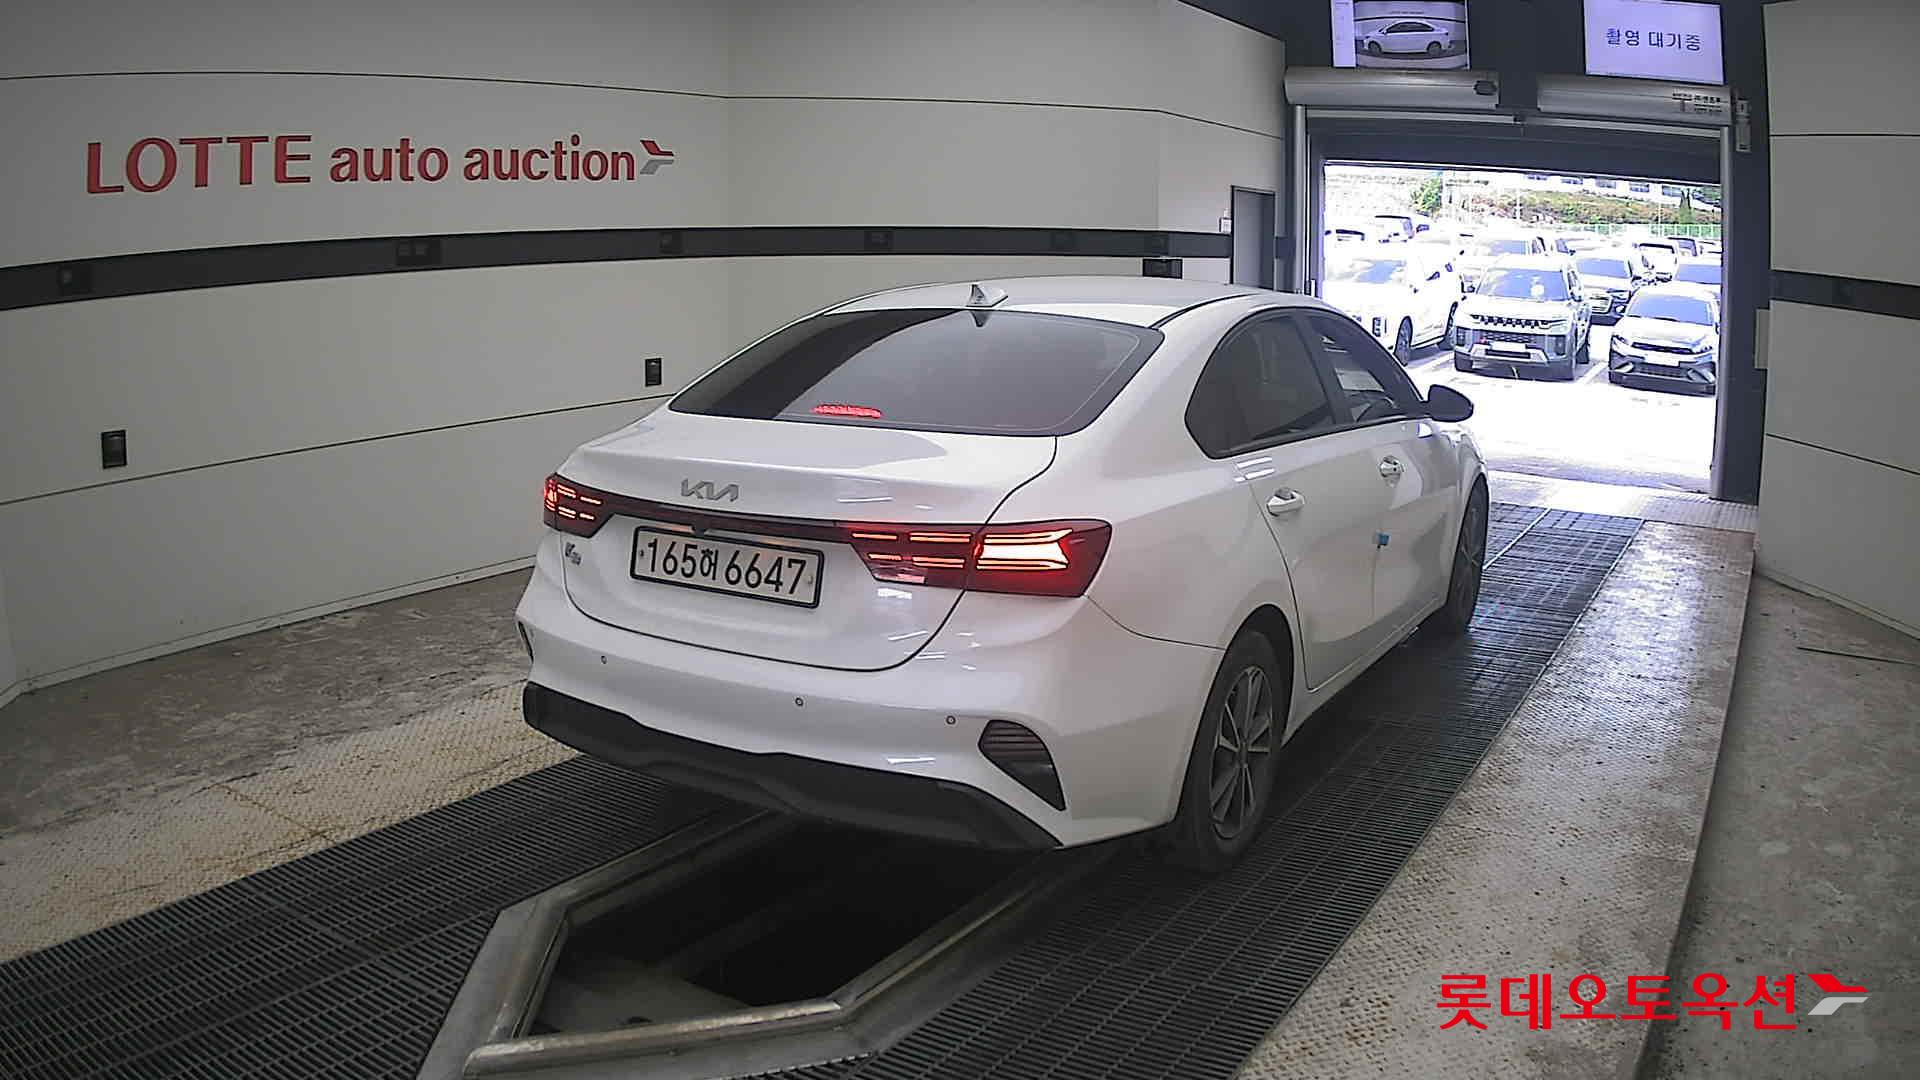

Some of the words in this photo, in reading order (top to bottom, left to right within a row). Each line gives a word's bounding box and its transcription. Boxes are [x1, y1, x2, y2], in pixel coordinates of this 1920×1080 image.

[1648, 31, 1701, 51] 대기중
[87, 135, 313, 194] LOTTE
[331, 138, 448, 183] auto
[464, 133, 636, 182] auction
[647, 538, 718, 581] 165허
[725, 549, 807, 595] 6647
